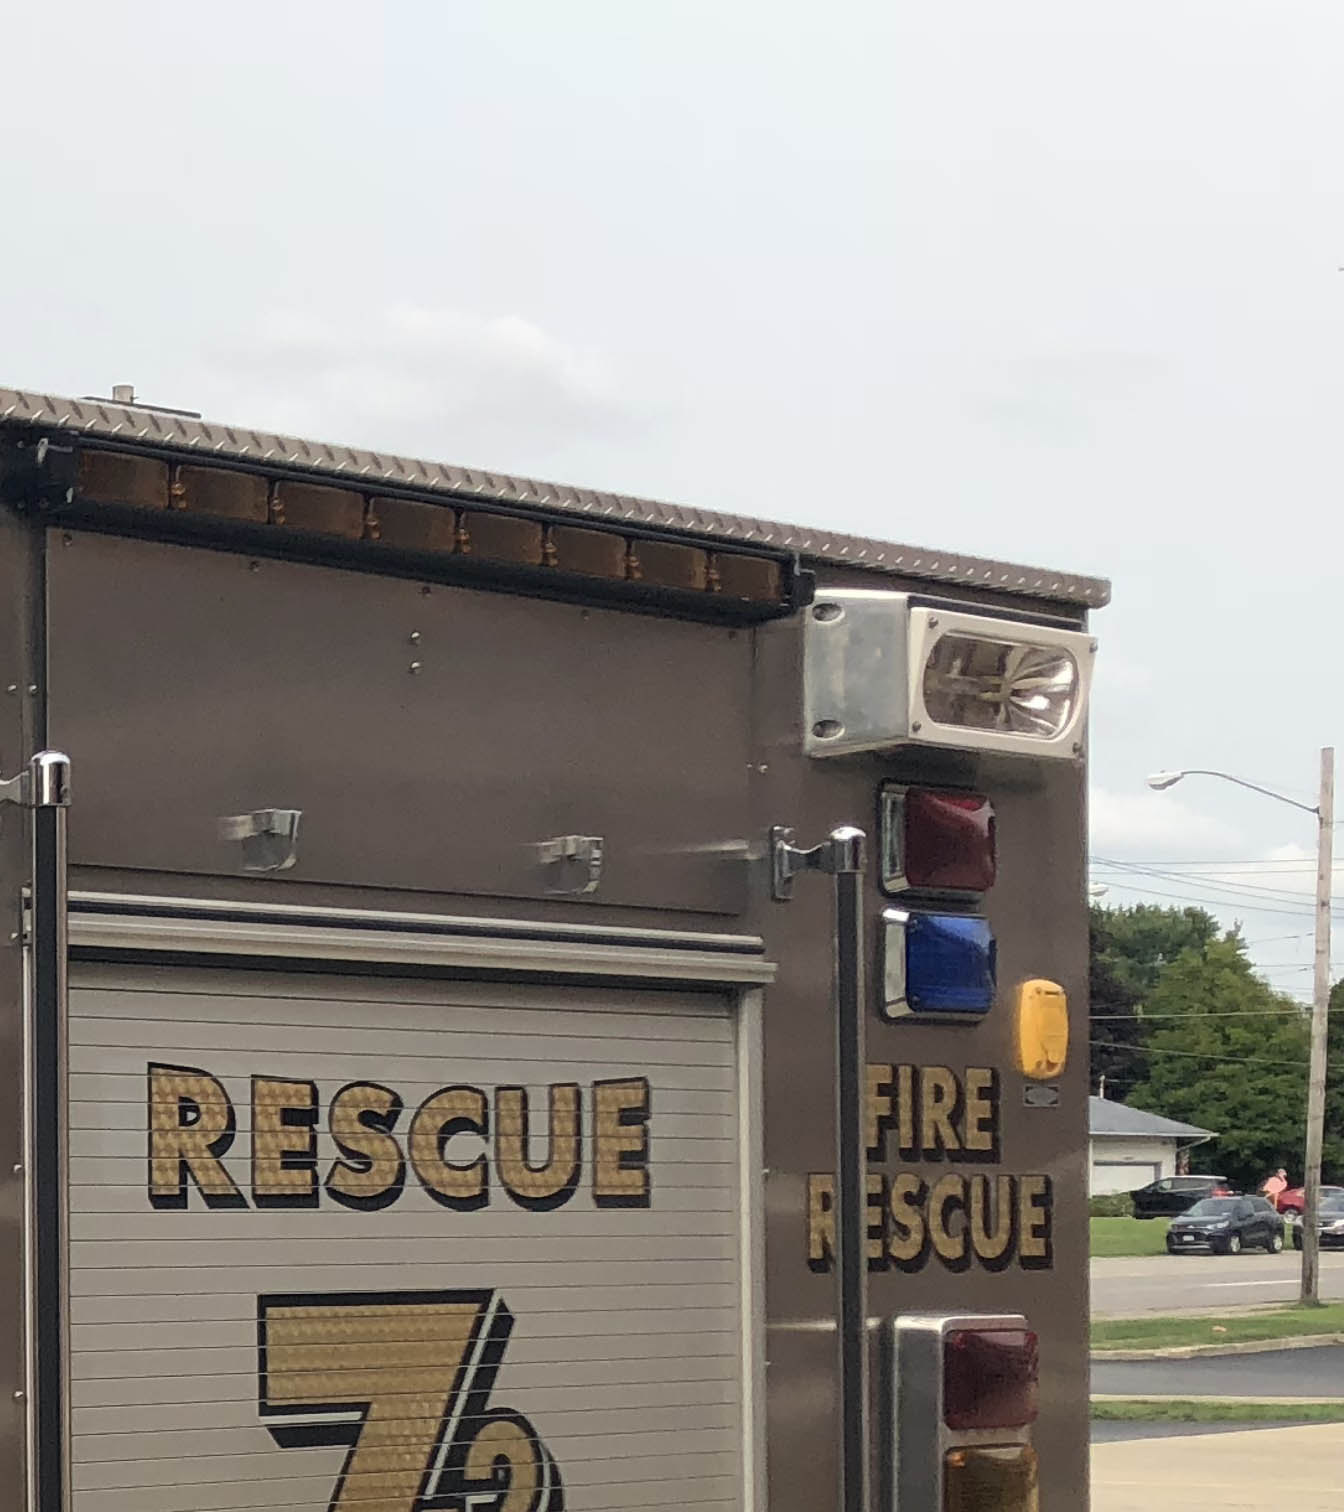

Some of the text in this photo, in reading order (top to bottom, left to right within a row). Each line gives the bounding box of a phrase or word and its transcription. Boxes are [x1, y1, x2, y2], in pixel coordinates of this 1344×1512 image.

[147, 1061, 651, 1211] RESCUE
[864, 1063, 1001, 1164] FIRE
[808, 1172, 1053, 1274] RESCUE
